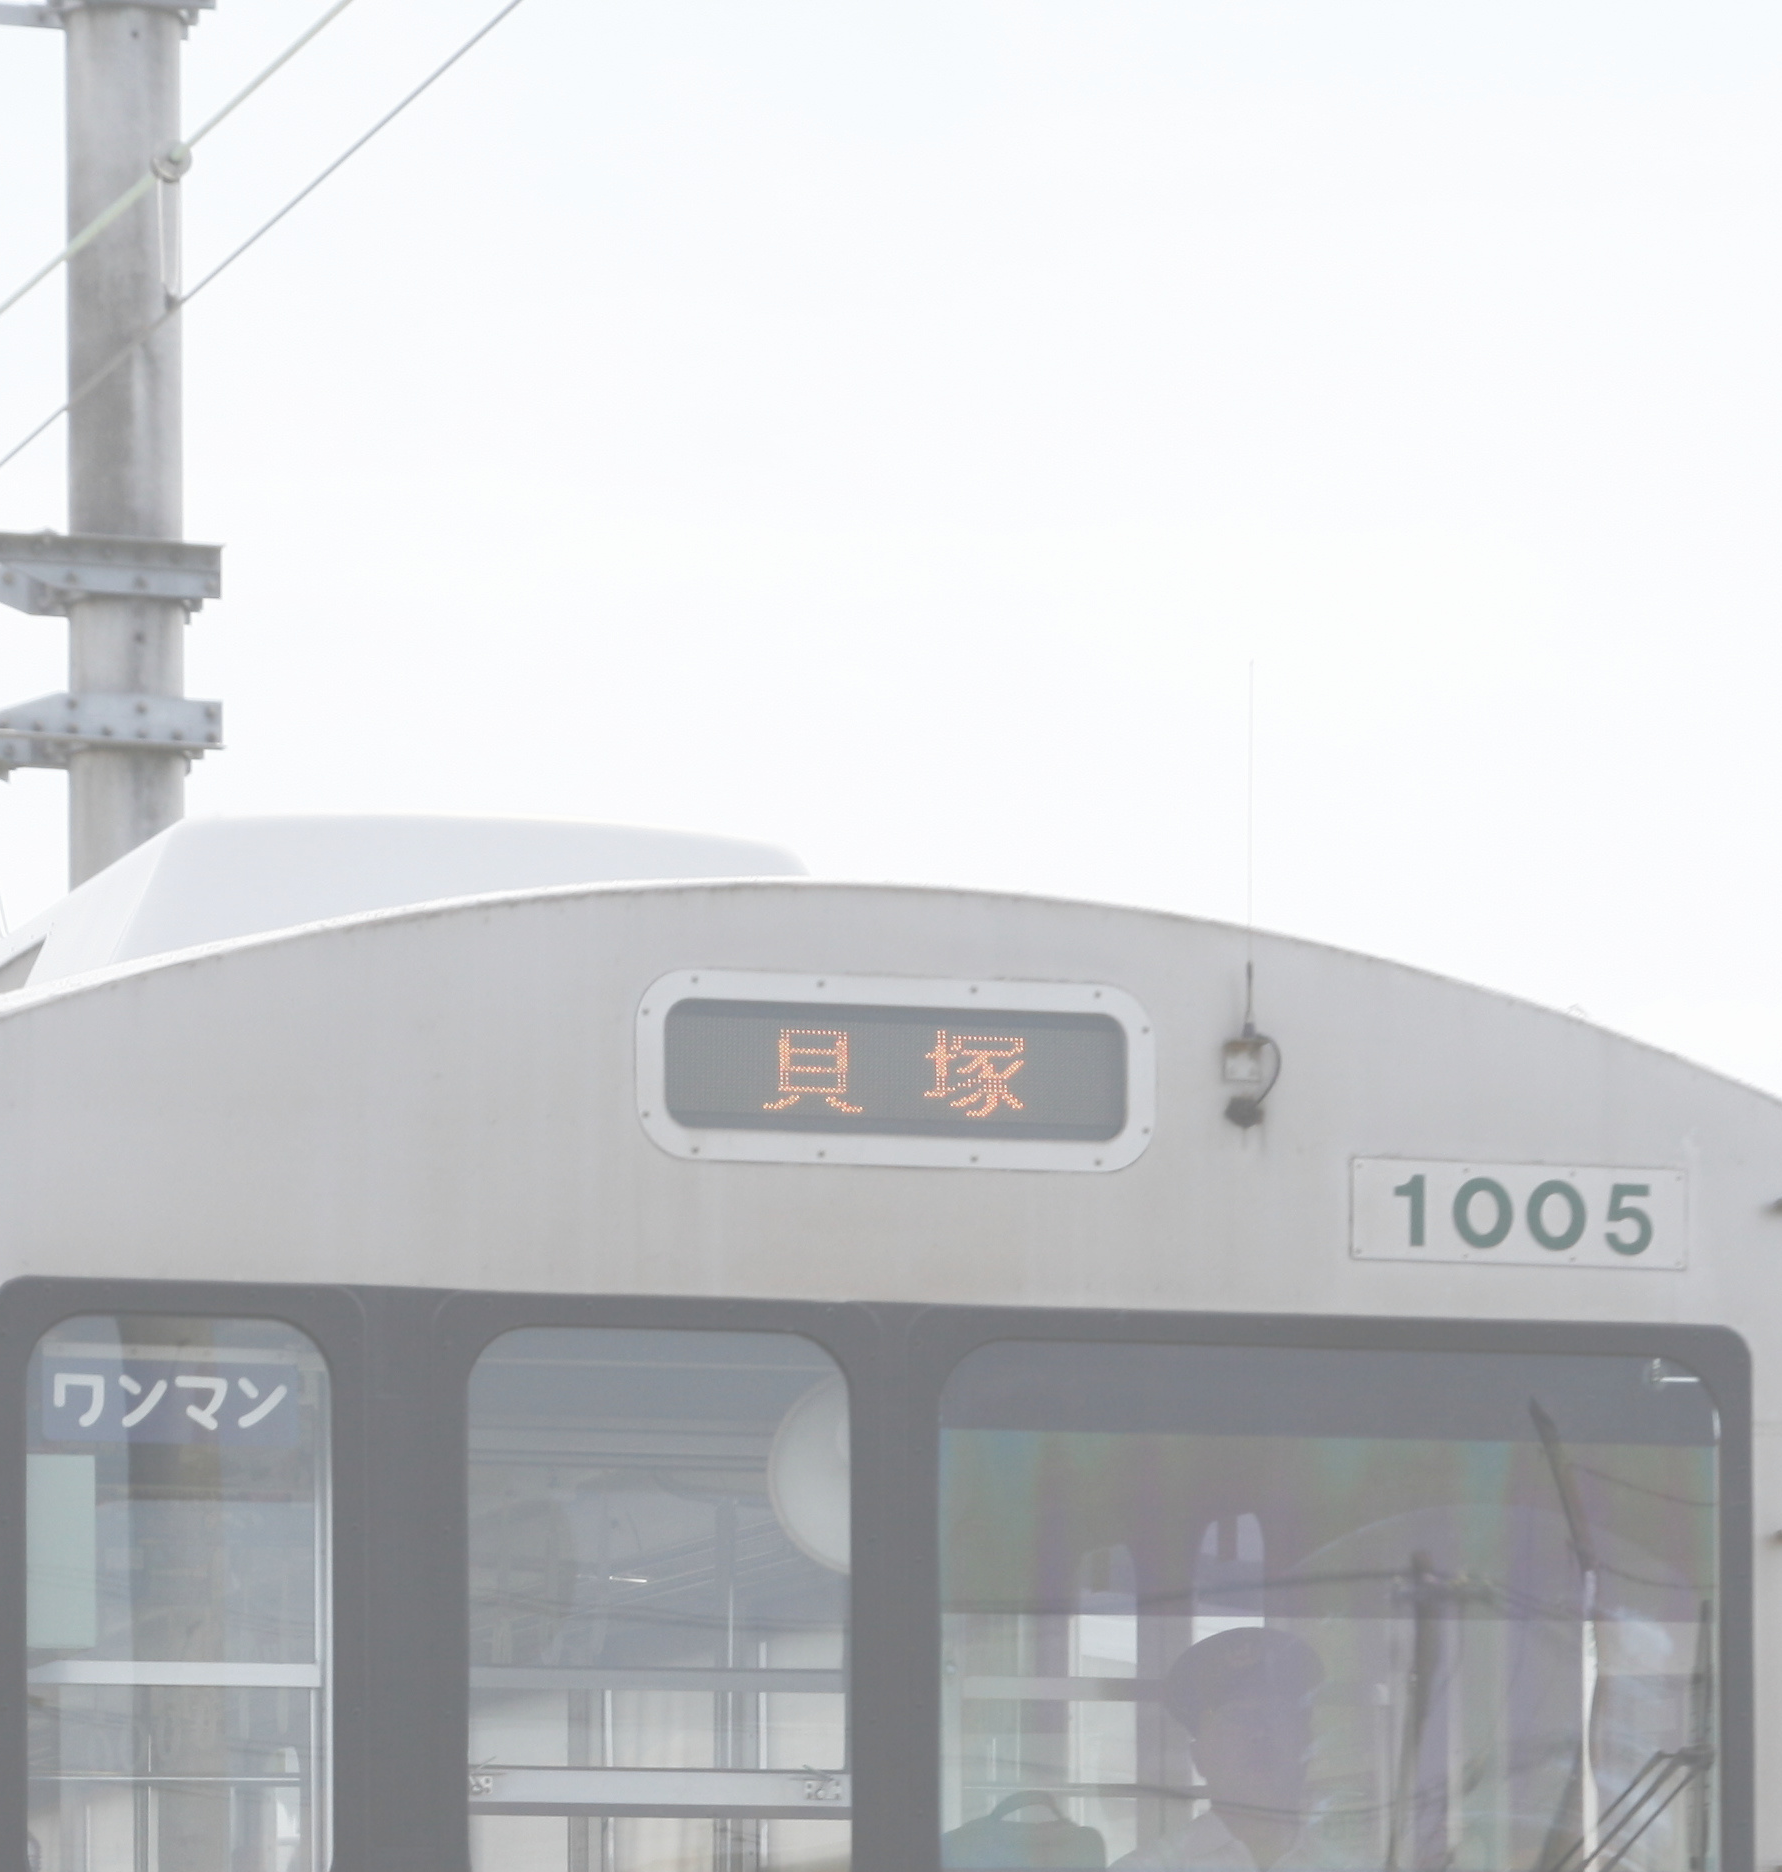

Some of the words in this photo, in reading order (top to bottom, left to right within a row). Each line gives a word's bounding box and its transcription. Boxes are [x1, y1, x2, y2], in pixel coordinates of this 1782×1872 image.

[763, 1028, 1025, 1117] 貝塚
[1394, 1173, 1652, 1256] 1005
[54, 1372, 287, 1430] ワンマン
